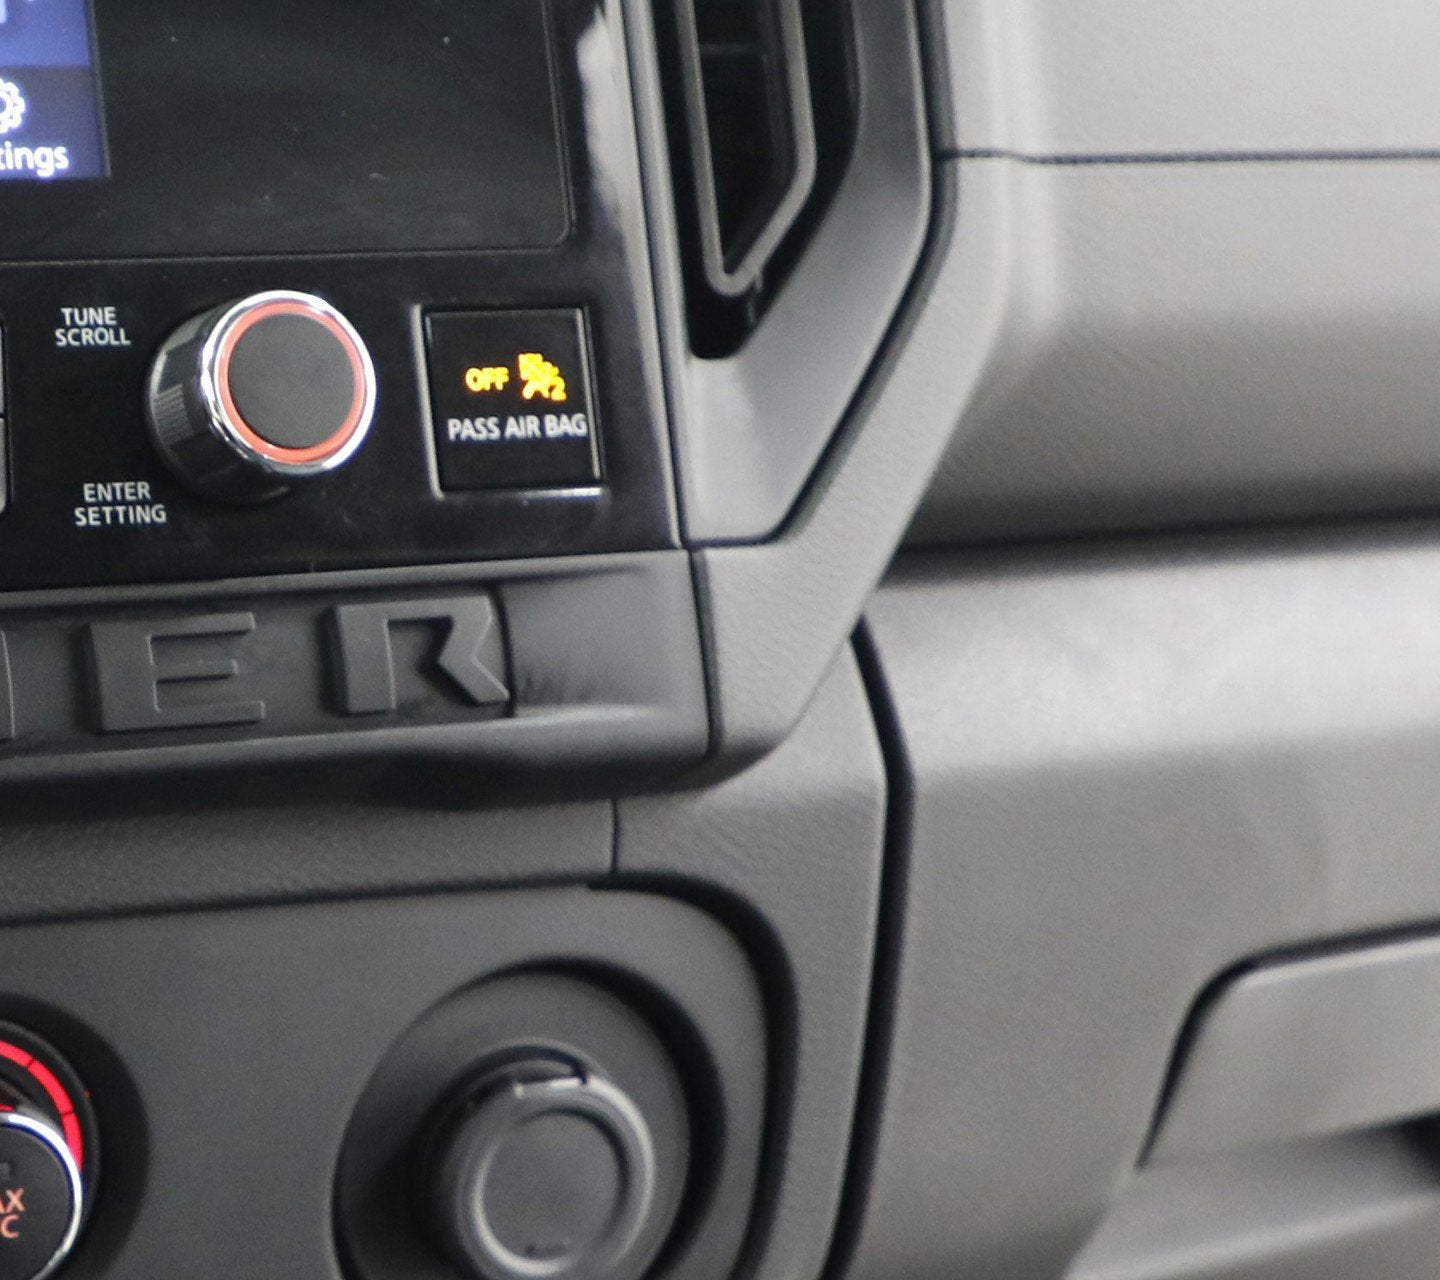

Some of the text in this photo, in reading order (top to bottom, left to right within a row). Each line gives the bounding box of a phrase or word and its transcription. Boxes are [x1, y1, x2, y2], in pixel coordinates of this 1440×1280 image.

[61, 307, 117, 327] TUNE
[55, 326, 130, 348] SCROLL
[465, 366, 509, 393] OFF
[447, 413, 588, 441] PASS AIR BAG
[83, 481, 151, 503] ENTER
[74, 503, 167, 526] SETTING
